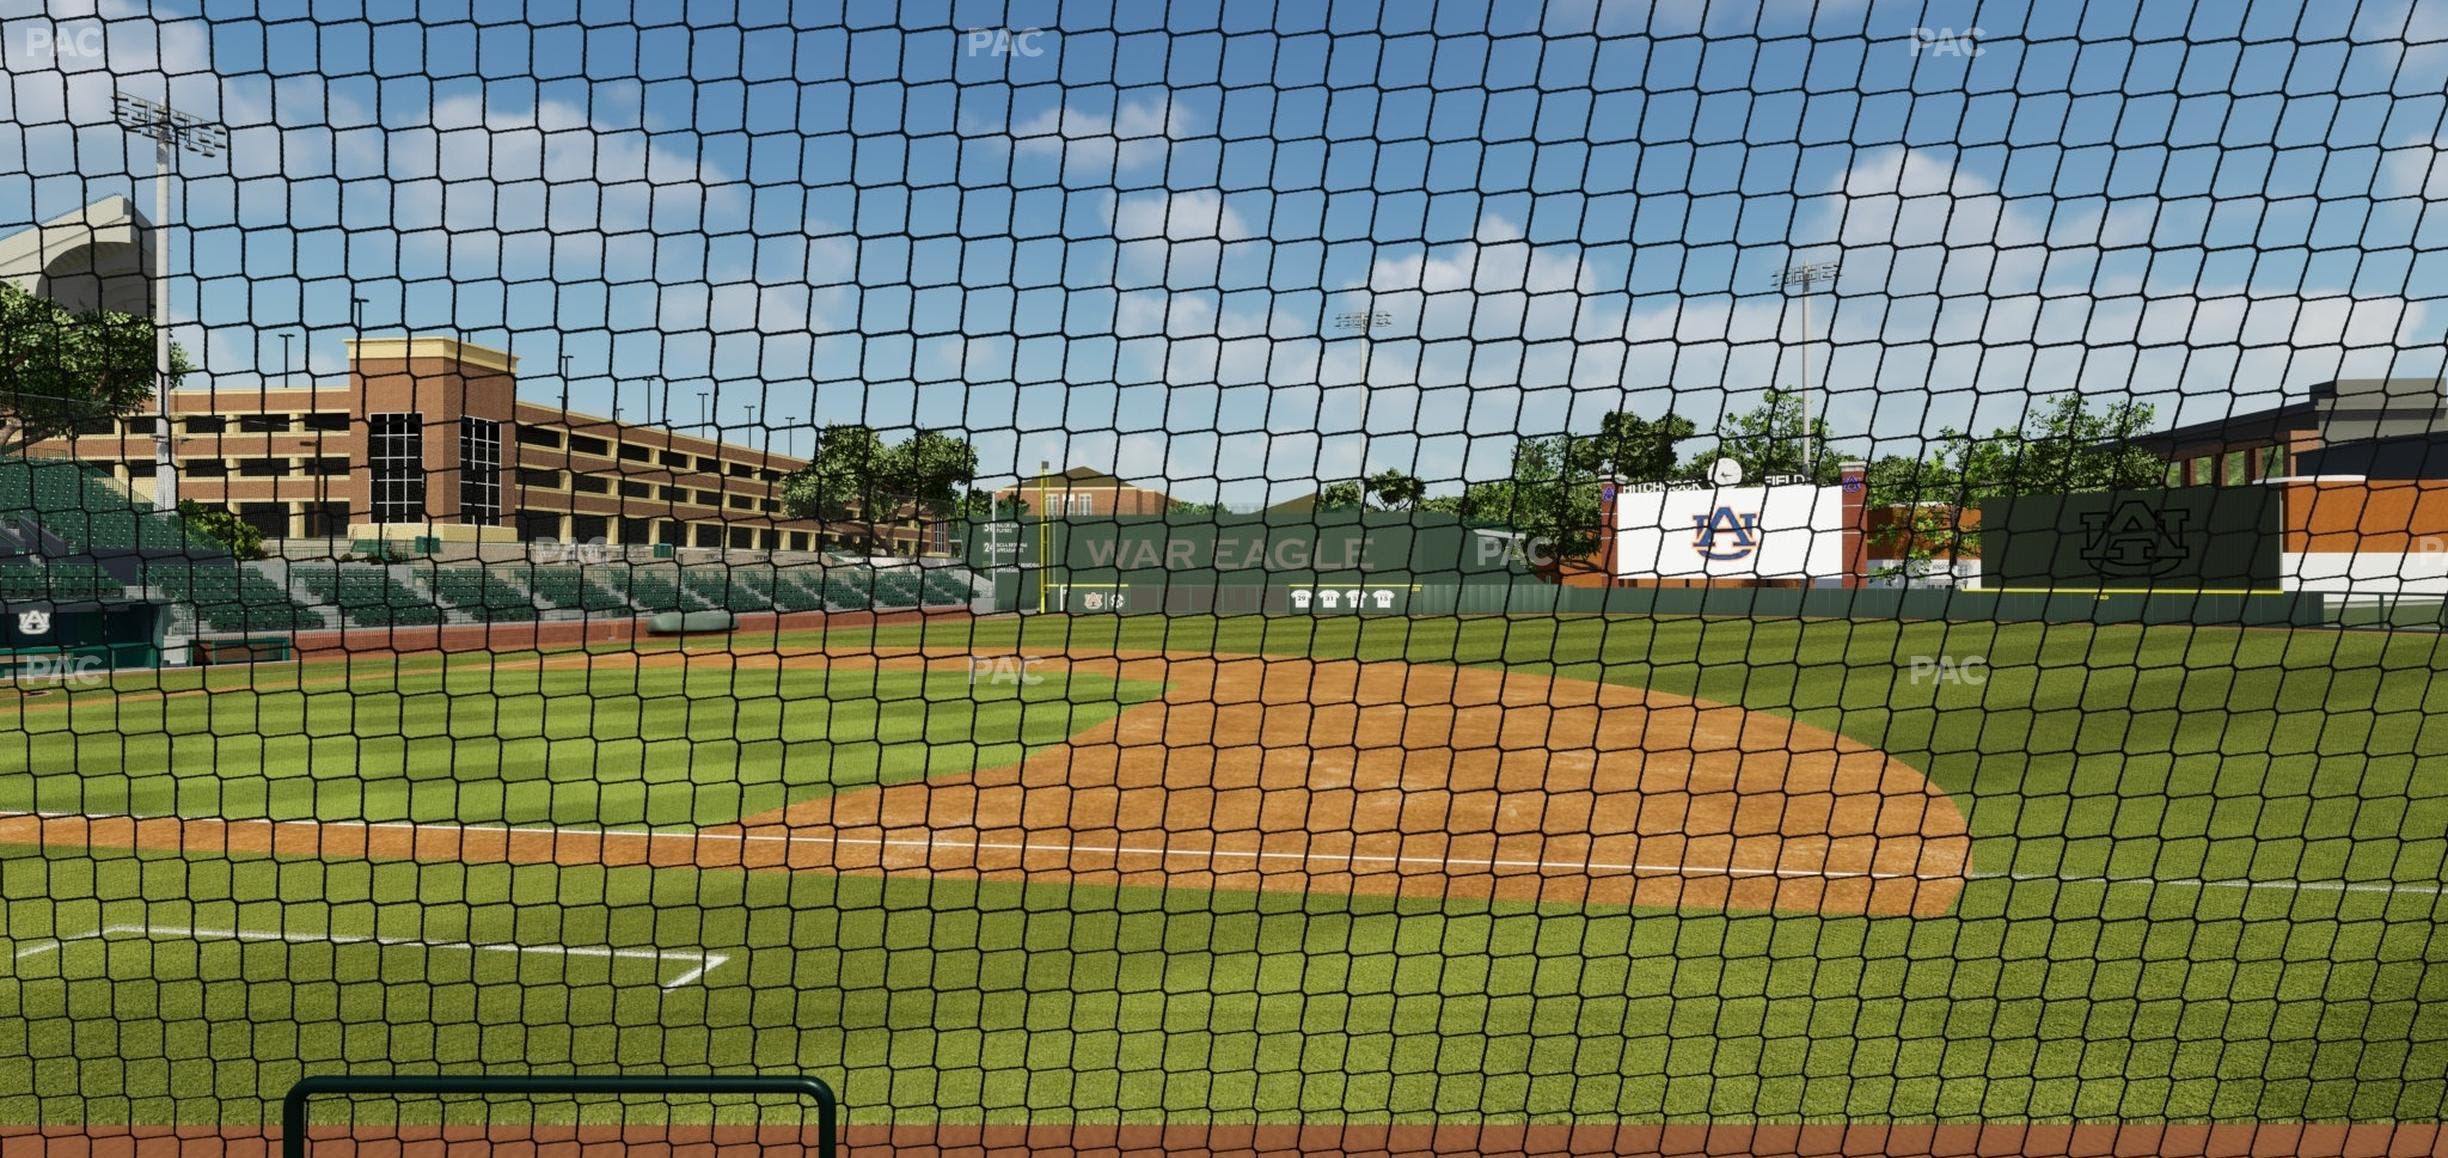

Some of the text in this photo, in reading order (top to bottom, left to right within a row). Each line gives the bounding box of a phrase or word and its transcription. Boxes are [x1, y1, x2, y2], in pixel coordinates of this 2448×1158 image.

[1765, 475, 1806, 486] FIELD
[1086, 538, 1374, 570] WAR EAGLE
